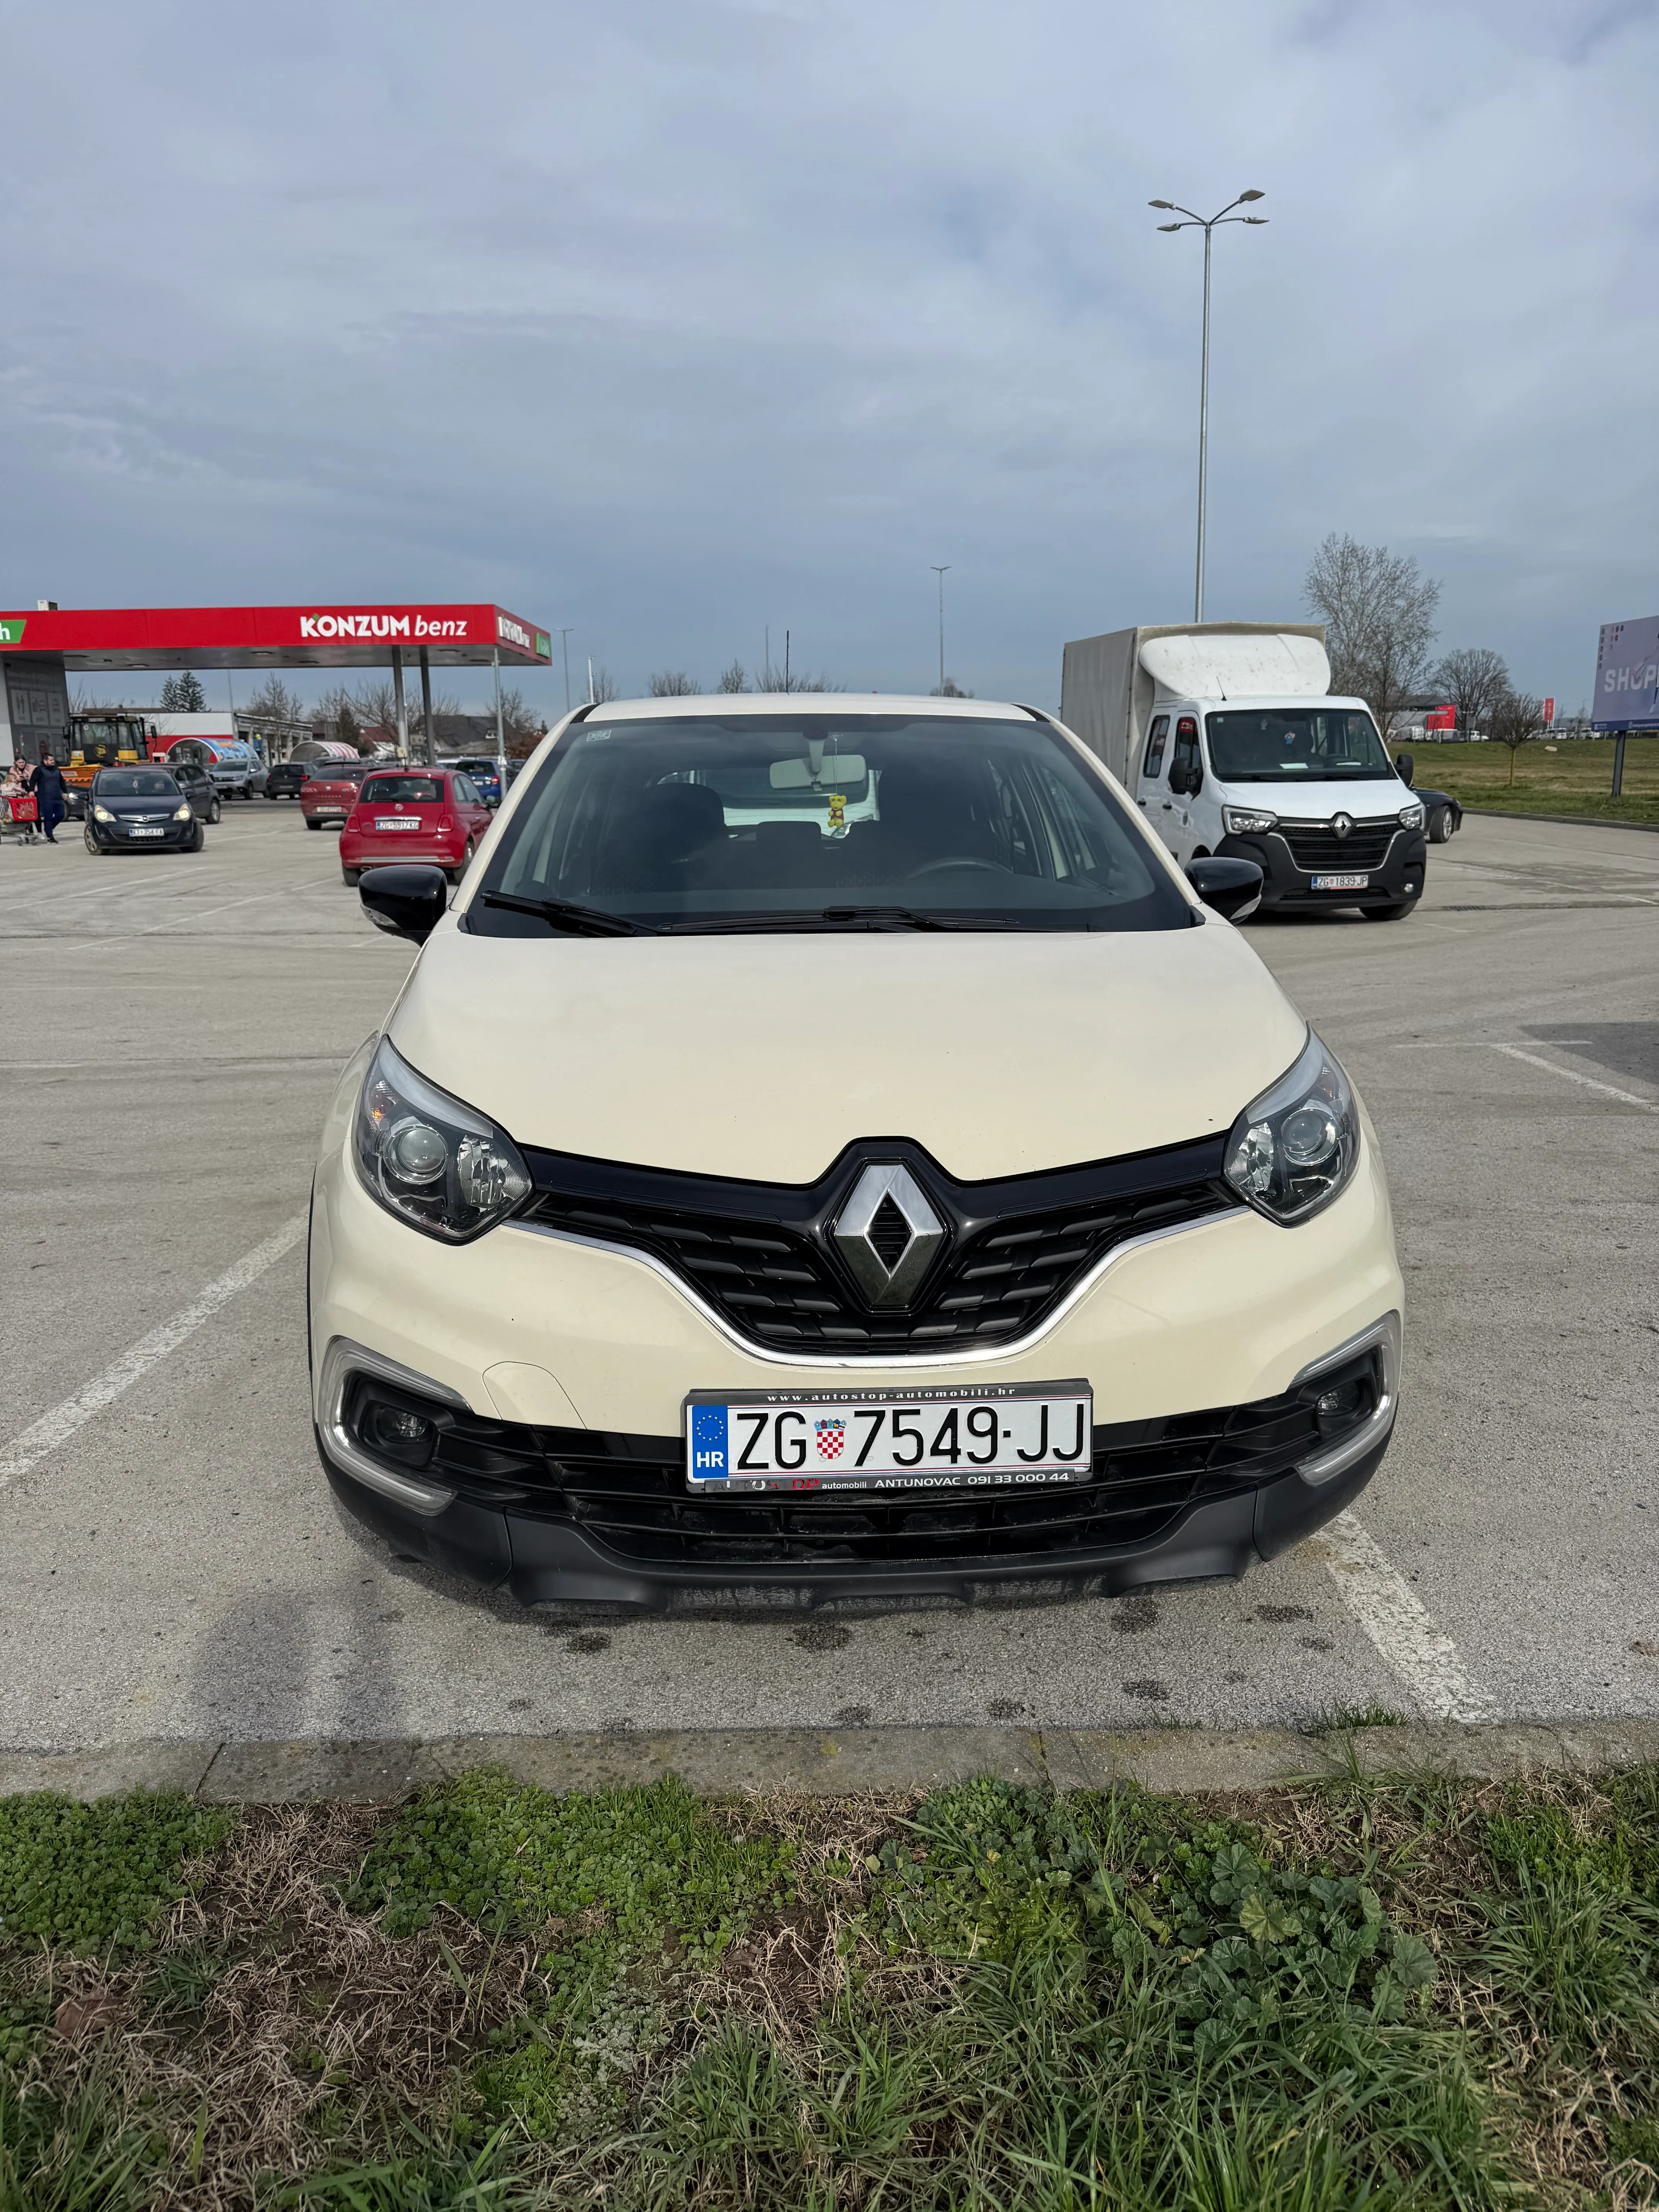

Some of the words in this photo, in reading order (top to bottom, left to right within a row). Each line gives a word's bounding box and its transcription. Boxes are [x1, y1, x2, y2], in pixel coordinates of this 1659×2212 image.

[301, 615, 410, 637] KONZUM
[415, 615, 467, 637] benz
[1318, 878, 1328, 887] ZG
[767, 1388, 1015, 1401] www.autostop-automobili.hr
[737, 1411, 806, 1469] ZG
[697, 1451, 724, 1468] HR
[874, 1477, 960, 1488] ANTUNOVAC
[967, 1476, 991, 1484] 091
[994, 1475, 1012, 1484] 33
[1015, 1474, 1046, 1482] 000
[1049, 1473, 1069, 1481] 44
